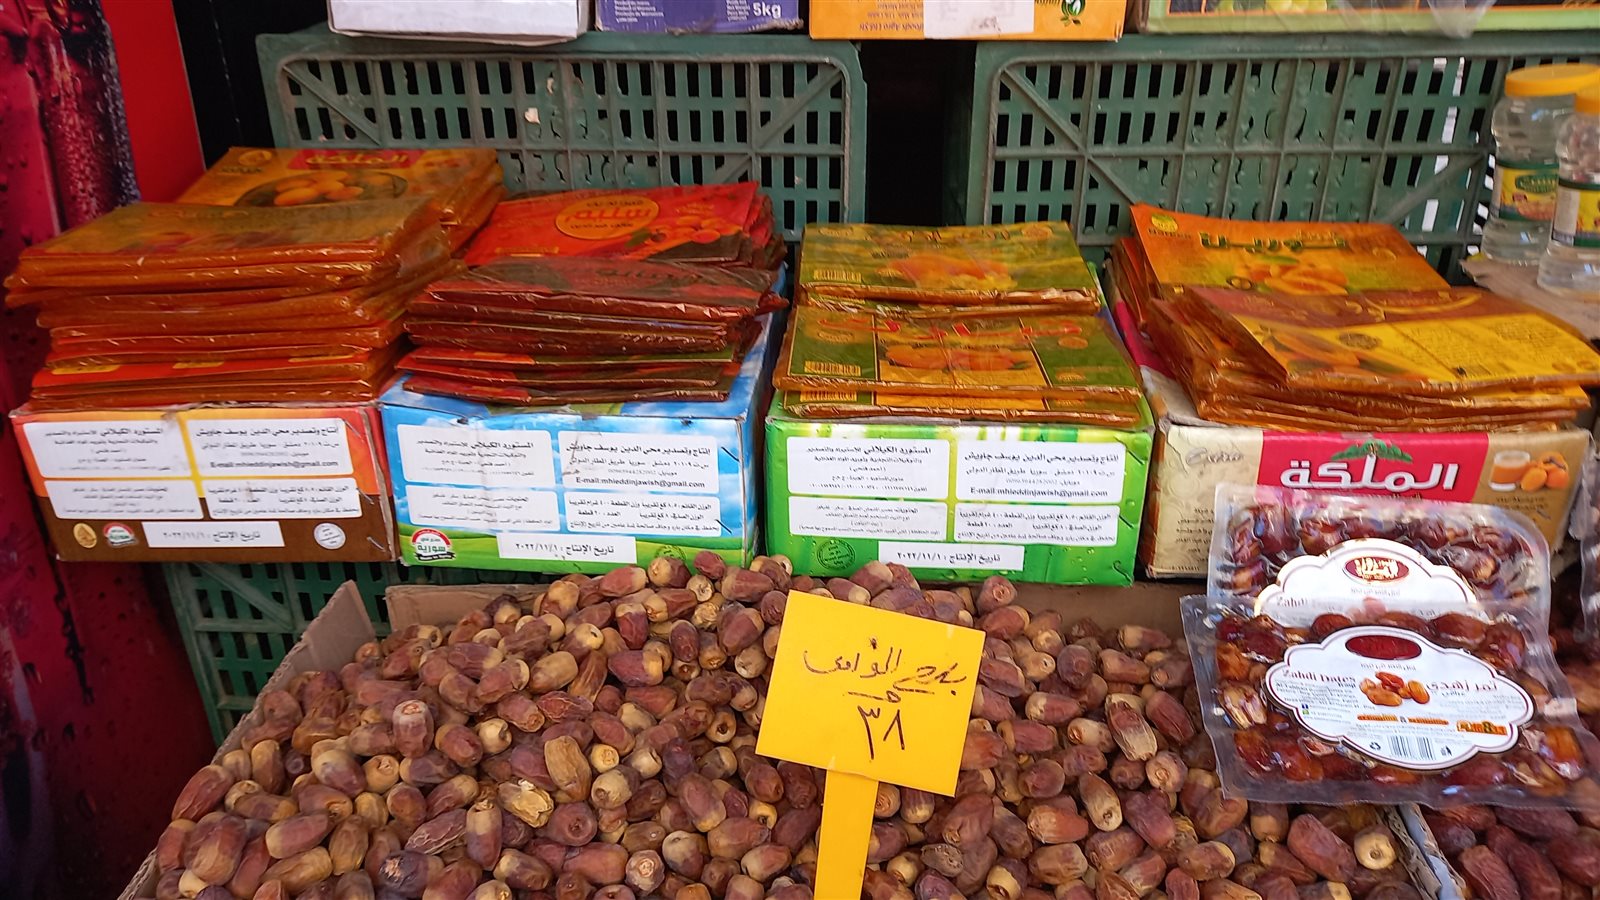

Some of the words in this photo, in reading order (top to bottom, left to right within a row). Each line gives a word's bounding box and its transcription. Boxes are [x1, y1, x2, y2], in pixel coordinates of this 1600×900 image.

[752, 2, 782, 19] 5kg
[1280, 454, 1459, 492] الملكة
[566, 543, 592, 555] الإنتاج
[593, 545, 614, 556] تاريخ
[949, 552, 977, 564] الإنتاج
[978, 554, 1001, 564] تاريخ
[1282, 669, 1317, 681] Zahdi
[1320, 673, 1356, 683] Dates
[858, 706, 905, 760] ٣٨
